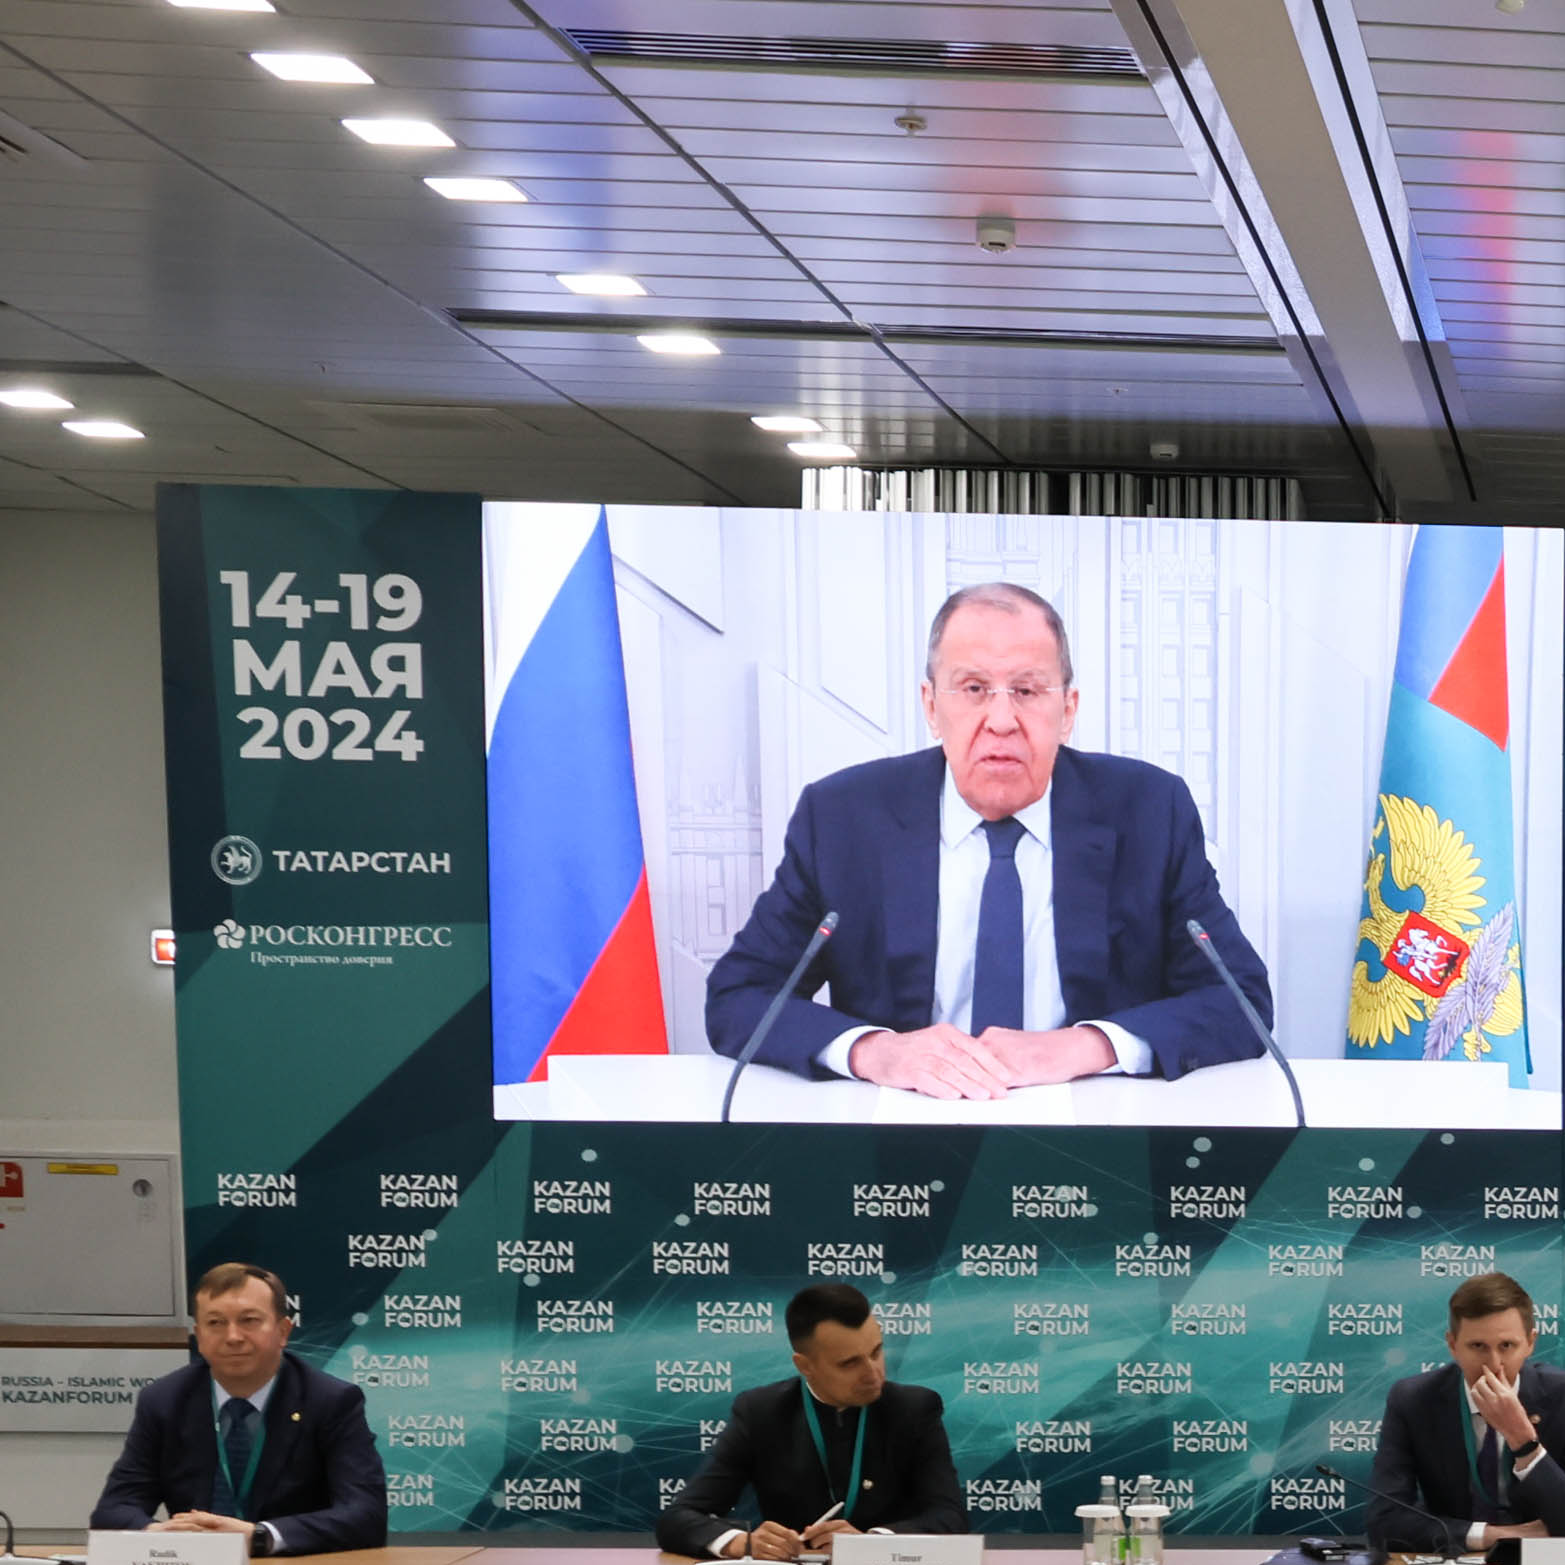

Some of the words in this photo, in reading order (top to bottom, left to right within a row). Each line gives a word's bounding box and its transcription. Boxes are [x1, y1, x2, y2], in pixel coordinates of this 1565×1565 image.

[220, 571, 422, 631] 14-19
[233, 640, 422, 698] МАЯ
[237, 707, 424, 761] 2024
[273, 851, 450, 872] ТАТАРСТАН
[251, 926, 451, 946] РОСКОНГРЕСС
[219, 1174, 295, 1192] KAZAN
[534, 1181, 609, 1196] KAZAN
[219, 1192, 295, 1206] FORUM
[854, 1185, 929, 1199] KAZAN
[1329, 1187, 1402, 1201] KAZAN
[535, 1199, 610, 1213] FORUM
[854, 1202, 929, 1216] FORUM
[1329, 1204, 1402, 1218] FORUM
[349, 1235, 425, 1250] KAZAN
[654, 1243, 728, 1257] KAZAN
[963, 1245, 1036, 1259] KAZAN
[1269, 1245, 1342, 1259] KAZAN
[350, 1253, 425, 1267] FORUM
[654, 1259, 728, 1274] FORUM
[962, 1262, 1037, 1276] FORUM
[1270, 1262, 1342, 1276] FORUM
[385, 1296, 460, 1310] KAZAN
[697, 1302, 771, 1316] KAZAN
[386, 1313, 460, 1327] FORUM
[1172, 1305, 1245, 1321] KAZAN
[698, 1319, 771, 1333] FORUM
[1172, 1321, 1245, 1335] FORUM
[502, 1360, 576, 1374] KAZAN
[964, 1363, 1038, 1376] KAZAN
[1270, 1363, 1343, 1376] KAZAN
[1, 1376, 53, 1387] RUSSIA
[68, 1377, 125, 1387] ISLAMIC
[503, 1377, 576, 1391] FORUM
[965, 1379, 1038, 1393] FORUM
[1271, 1379, 1343, 1393] FORUM
[1, 1391, 132, 1404] KAZANFORUM
[542, 1420, 616, 1433] KAZAN
[1174, 1421, 1246, 1435] KAZAN
[542, 1437, 615, 1451] FORUM
[1174, 1438, 1246, 1451] FORUM
[505, 1479, 580, 1493] KAZAN
[1272, 1479, 1344, 1493] KAZAN
[506, 1496, 580, 1510] FORUM
[1272, 1496, 1344, 1509] FORUM
